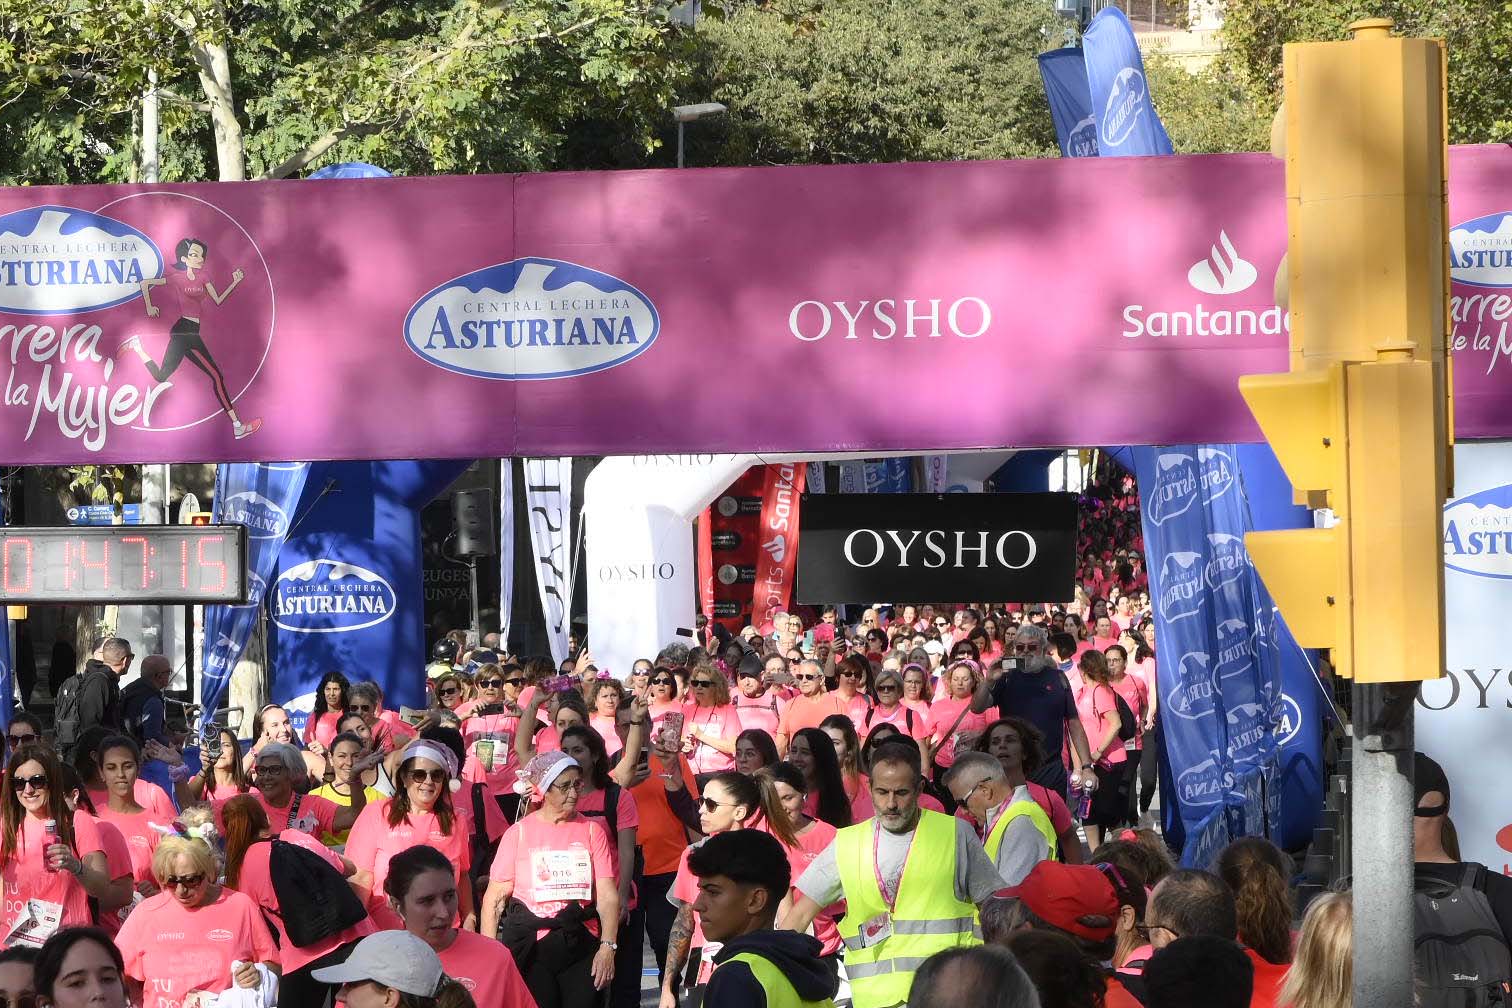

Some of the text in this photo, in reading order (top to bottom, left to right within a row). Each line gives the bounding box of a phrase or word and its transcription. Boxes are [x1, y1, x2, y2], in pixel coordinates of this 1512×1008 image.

[66, 241, 139, 254] LECHERA
[463, 298, 632, 314] CENTRAL LECHERA
[788, 296, 992, 341] OYSHO
[1122, 303, 1289, 338] Santand
[423, 305, 639, 350] ASTURIANA
[4, 366, 30, 406] la
[24, 357, 174, 452] Mujer
[843, 528, 1039, 570] OYSHO
[275, 589, 387, 617] ASTURIANA
[286, 583, 382, 594] CENTRAL LECHERA
